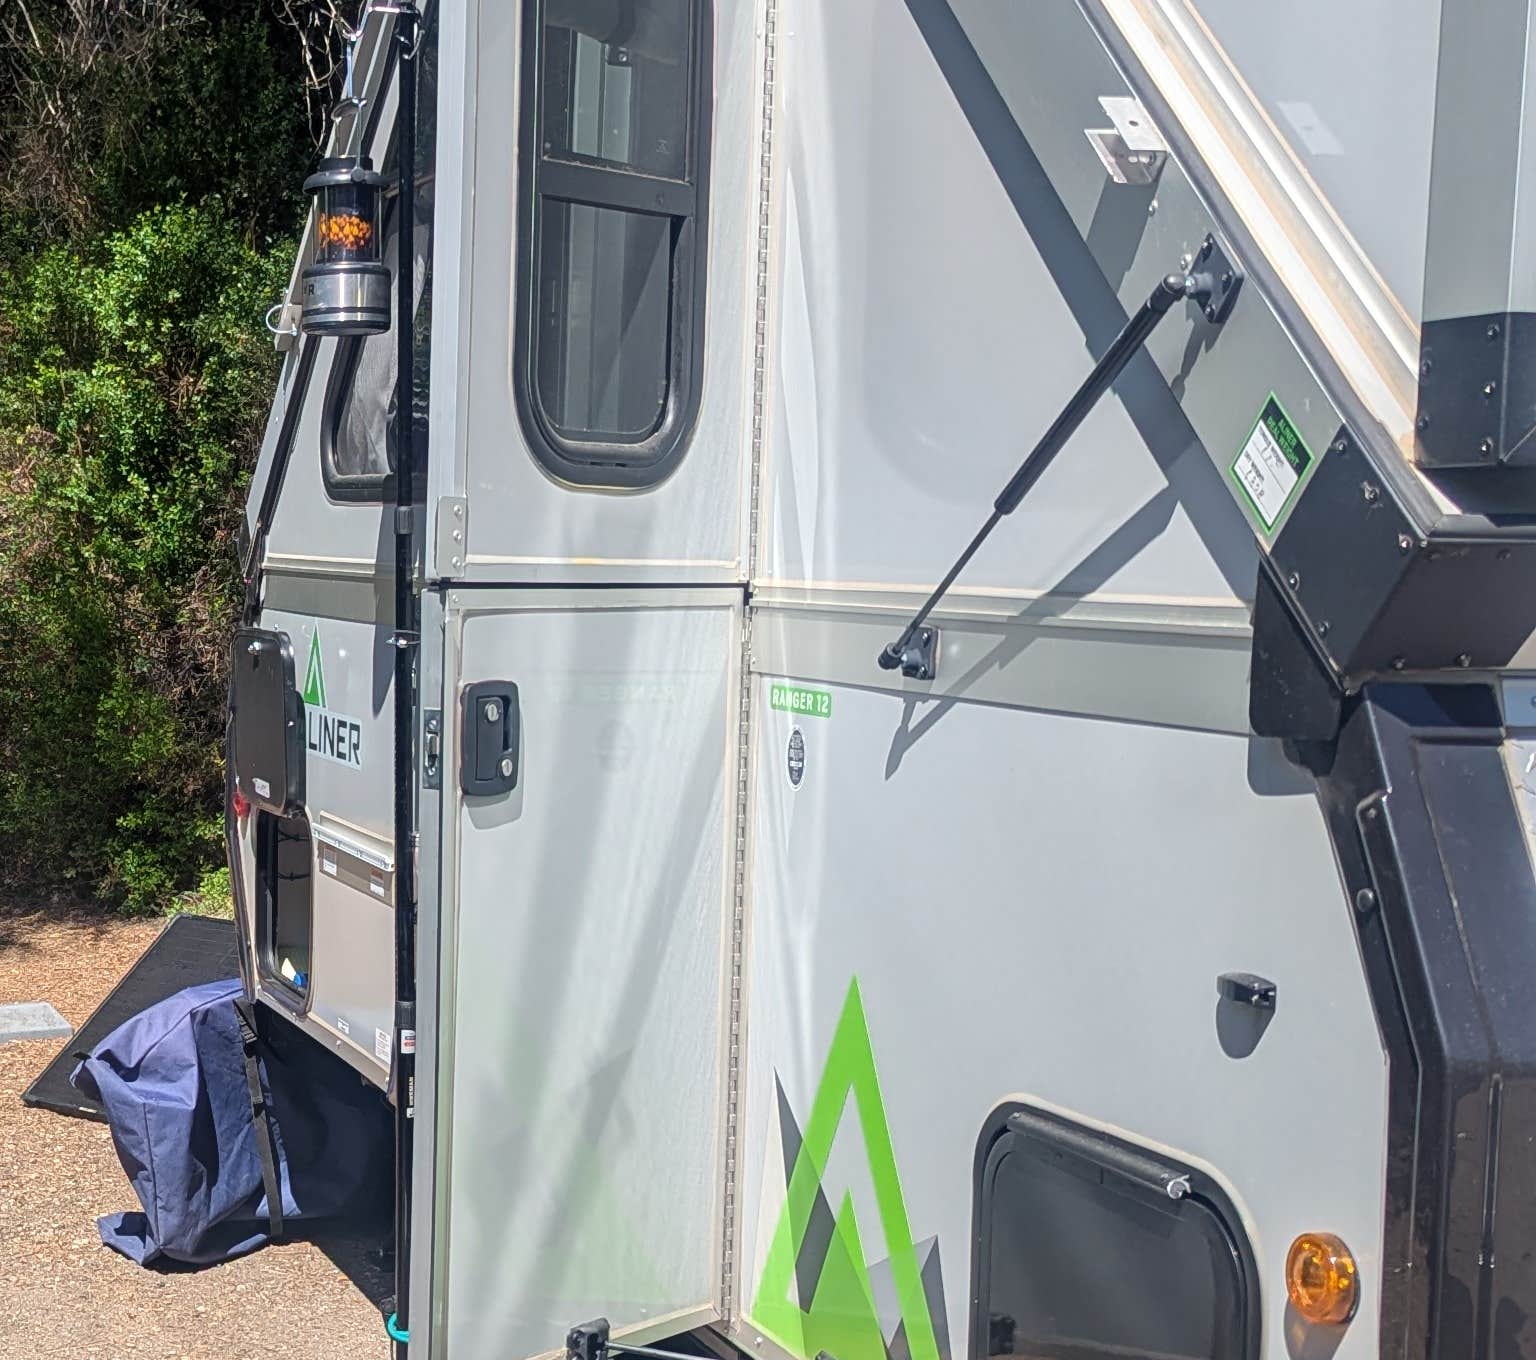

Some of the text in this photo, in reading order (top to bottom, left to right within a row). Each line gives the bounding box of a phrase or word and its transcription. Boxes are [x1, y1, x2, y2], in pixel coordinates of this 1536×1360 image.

[772, 687, 829, 714] RANGER 12
[307, 711, 361, 766] LINER
